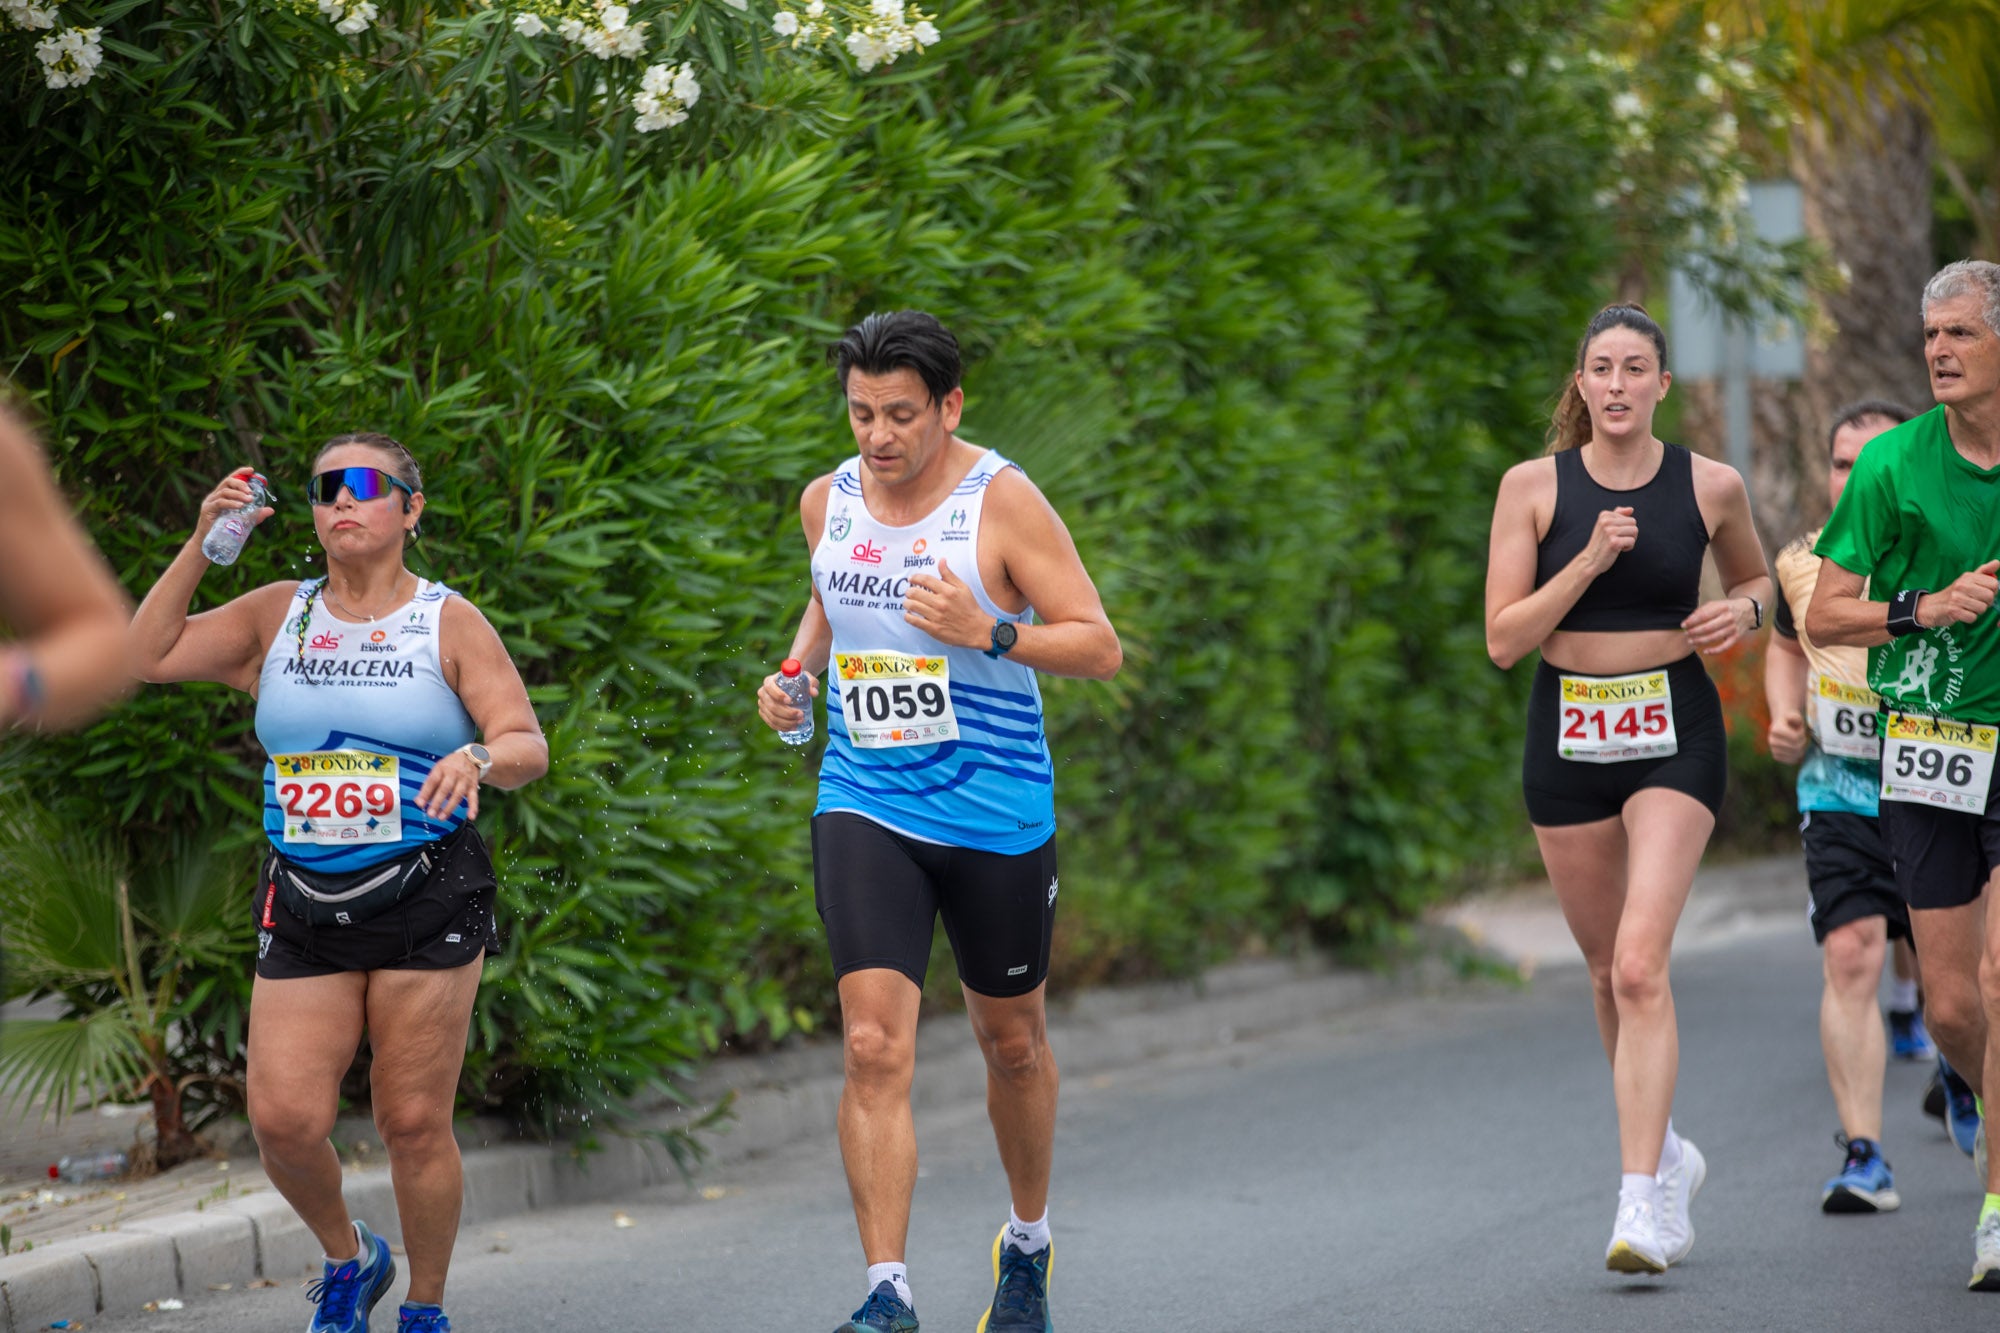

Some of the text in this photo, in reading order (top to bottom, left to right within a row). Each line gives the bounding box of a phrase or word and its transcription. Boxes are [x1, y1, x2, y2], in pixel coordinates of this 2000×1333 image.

[850, 539, 882, 564] als
[904, 555, 935, 569] mayfo
[828, 571, 933, 598] MARAC
[840, 597, 864, 607] CLUB
[867, 601, 881, 609] DE
[309, 630, 339, 650] als
[360, 642, 397, 654] mayfo
[283, 658, 414, 678] MARACENA
[849, 657, 864, 673] 38
[322, 678, 334, 687] DE
[338, 679, 397, 688] ATLETISMO
[1574, 683, 1588, 697] 38
[1943, 667, 1964, 704] Villa
[846, 682, 945, 722] 1059
[1564, 703, 1668, 742] 2145
[1835, 708, 1877, 738] 69
[1899, 720, 1917, 734] 38
[1895, 745, 1974, 787] 596
[280, 783, 394, 818] 2269
[1009, 1224, 1030, 1242] ILA
